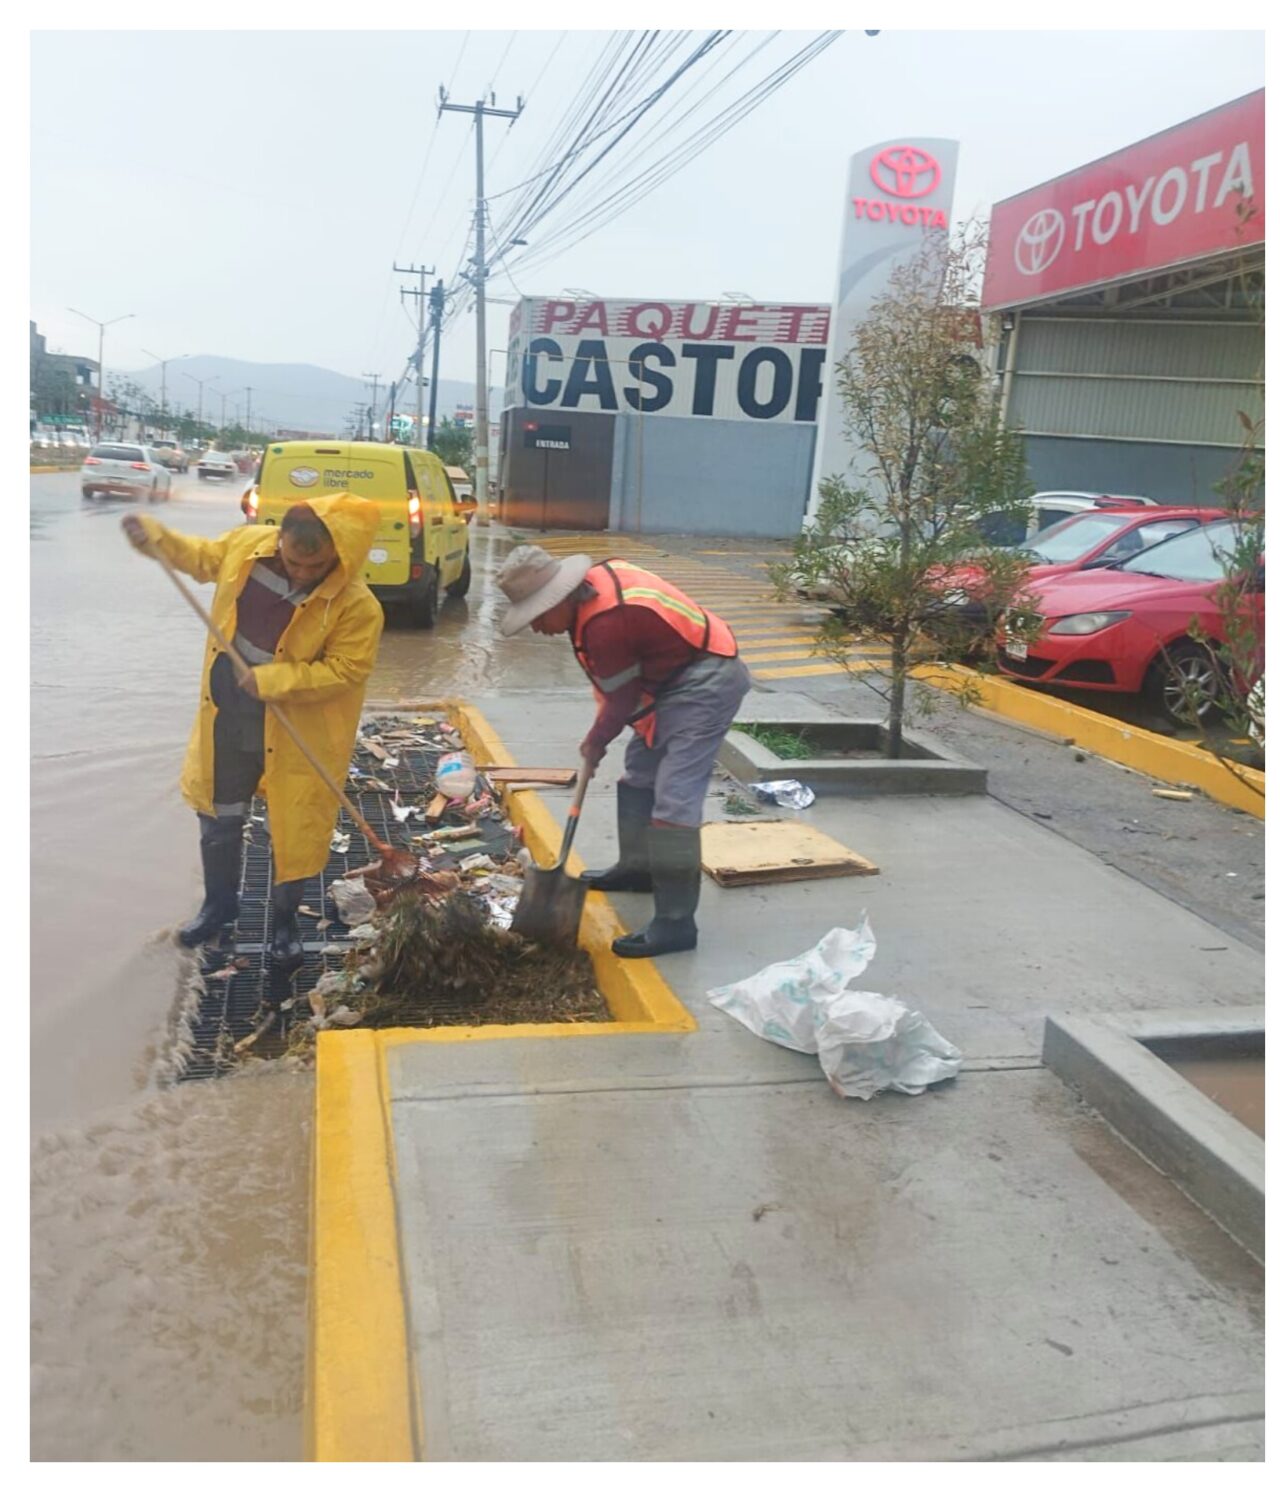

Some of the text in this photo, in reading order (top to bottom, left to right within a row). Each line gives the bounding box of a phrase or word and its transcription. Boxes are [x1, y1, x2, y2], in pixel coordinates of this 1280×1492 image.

[1072, 142, 1254, 252] TOYOTA
[852, 197, 949, 230] TOYOTA
[535, 439, 570, 449] ENTRADA
[323, 469, 374, 480] mercado
[323, 479, 349, 488] libre
